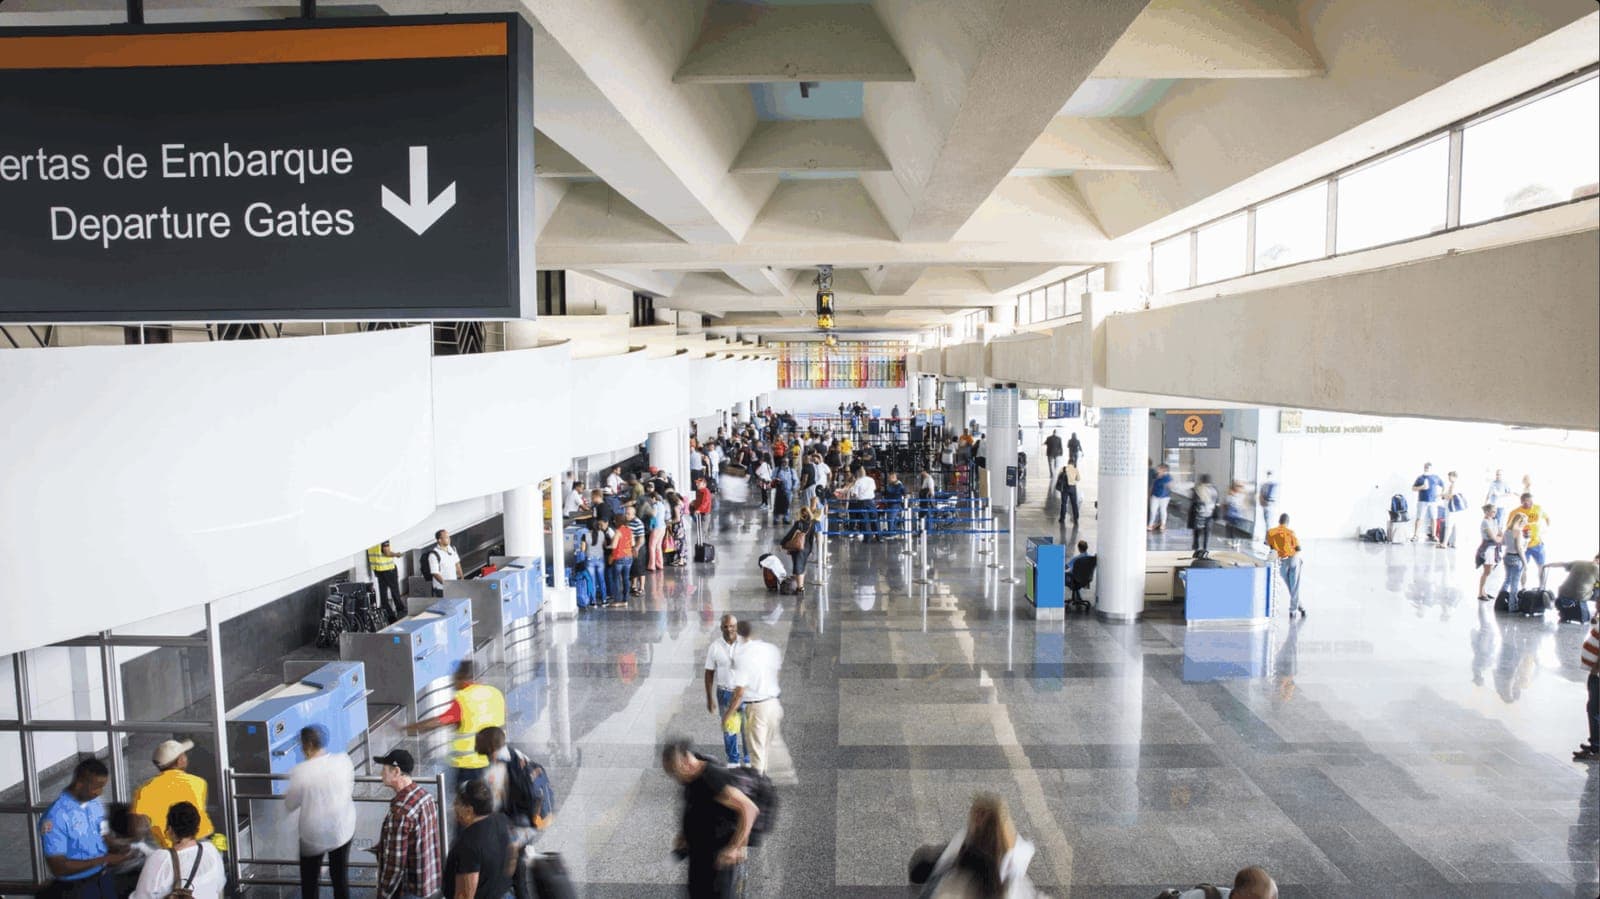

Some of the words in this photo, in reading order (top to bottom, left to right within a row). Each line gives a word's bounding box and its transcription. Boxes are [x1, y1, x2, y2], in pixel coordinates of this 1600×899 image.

[0, 147, 91, 181] ertas
[103, 145, 148, 179] de
[162, 142, 353, 184] Embarque
[50, 205, 231, 249] Departure
[244, 201, 355, 238] Gates
